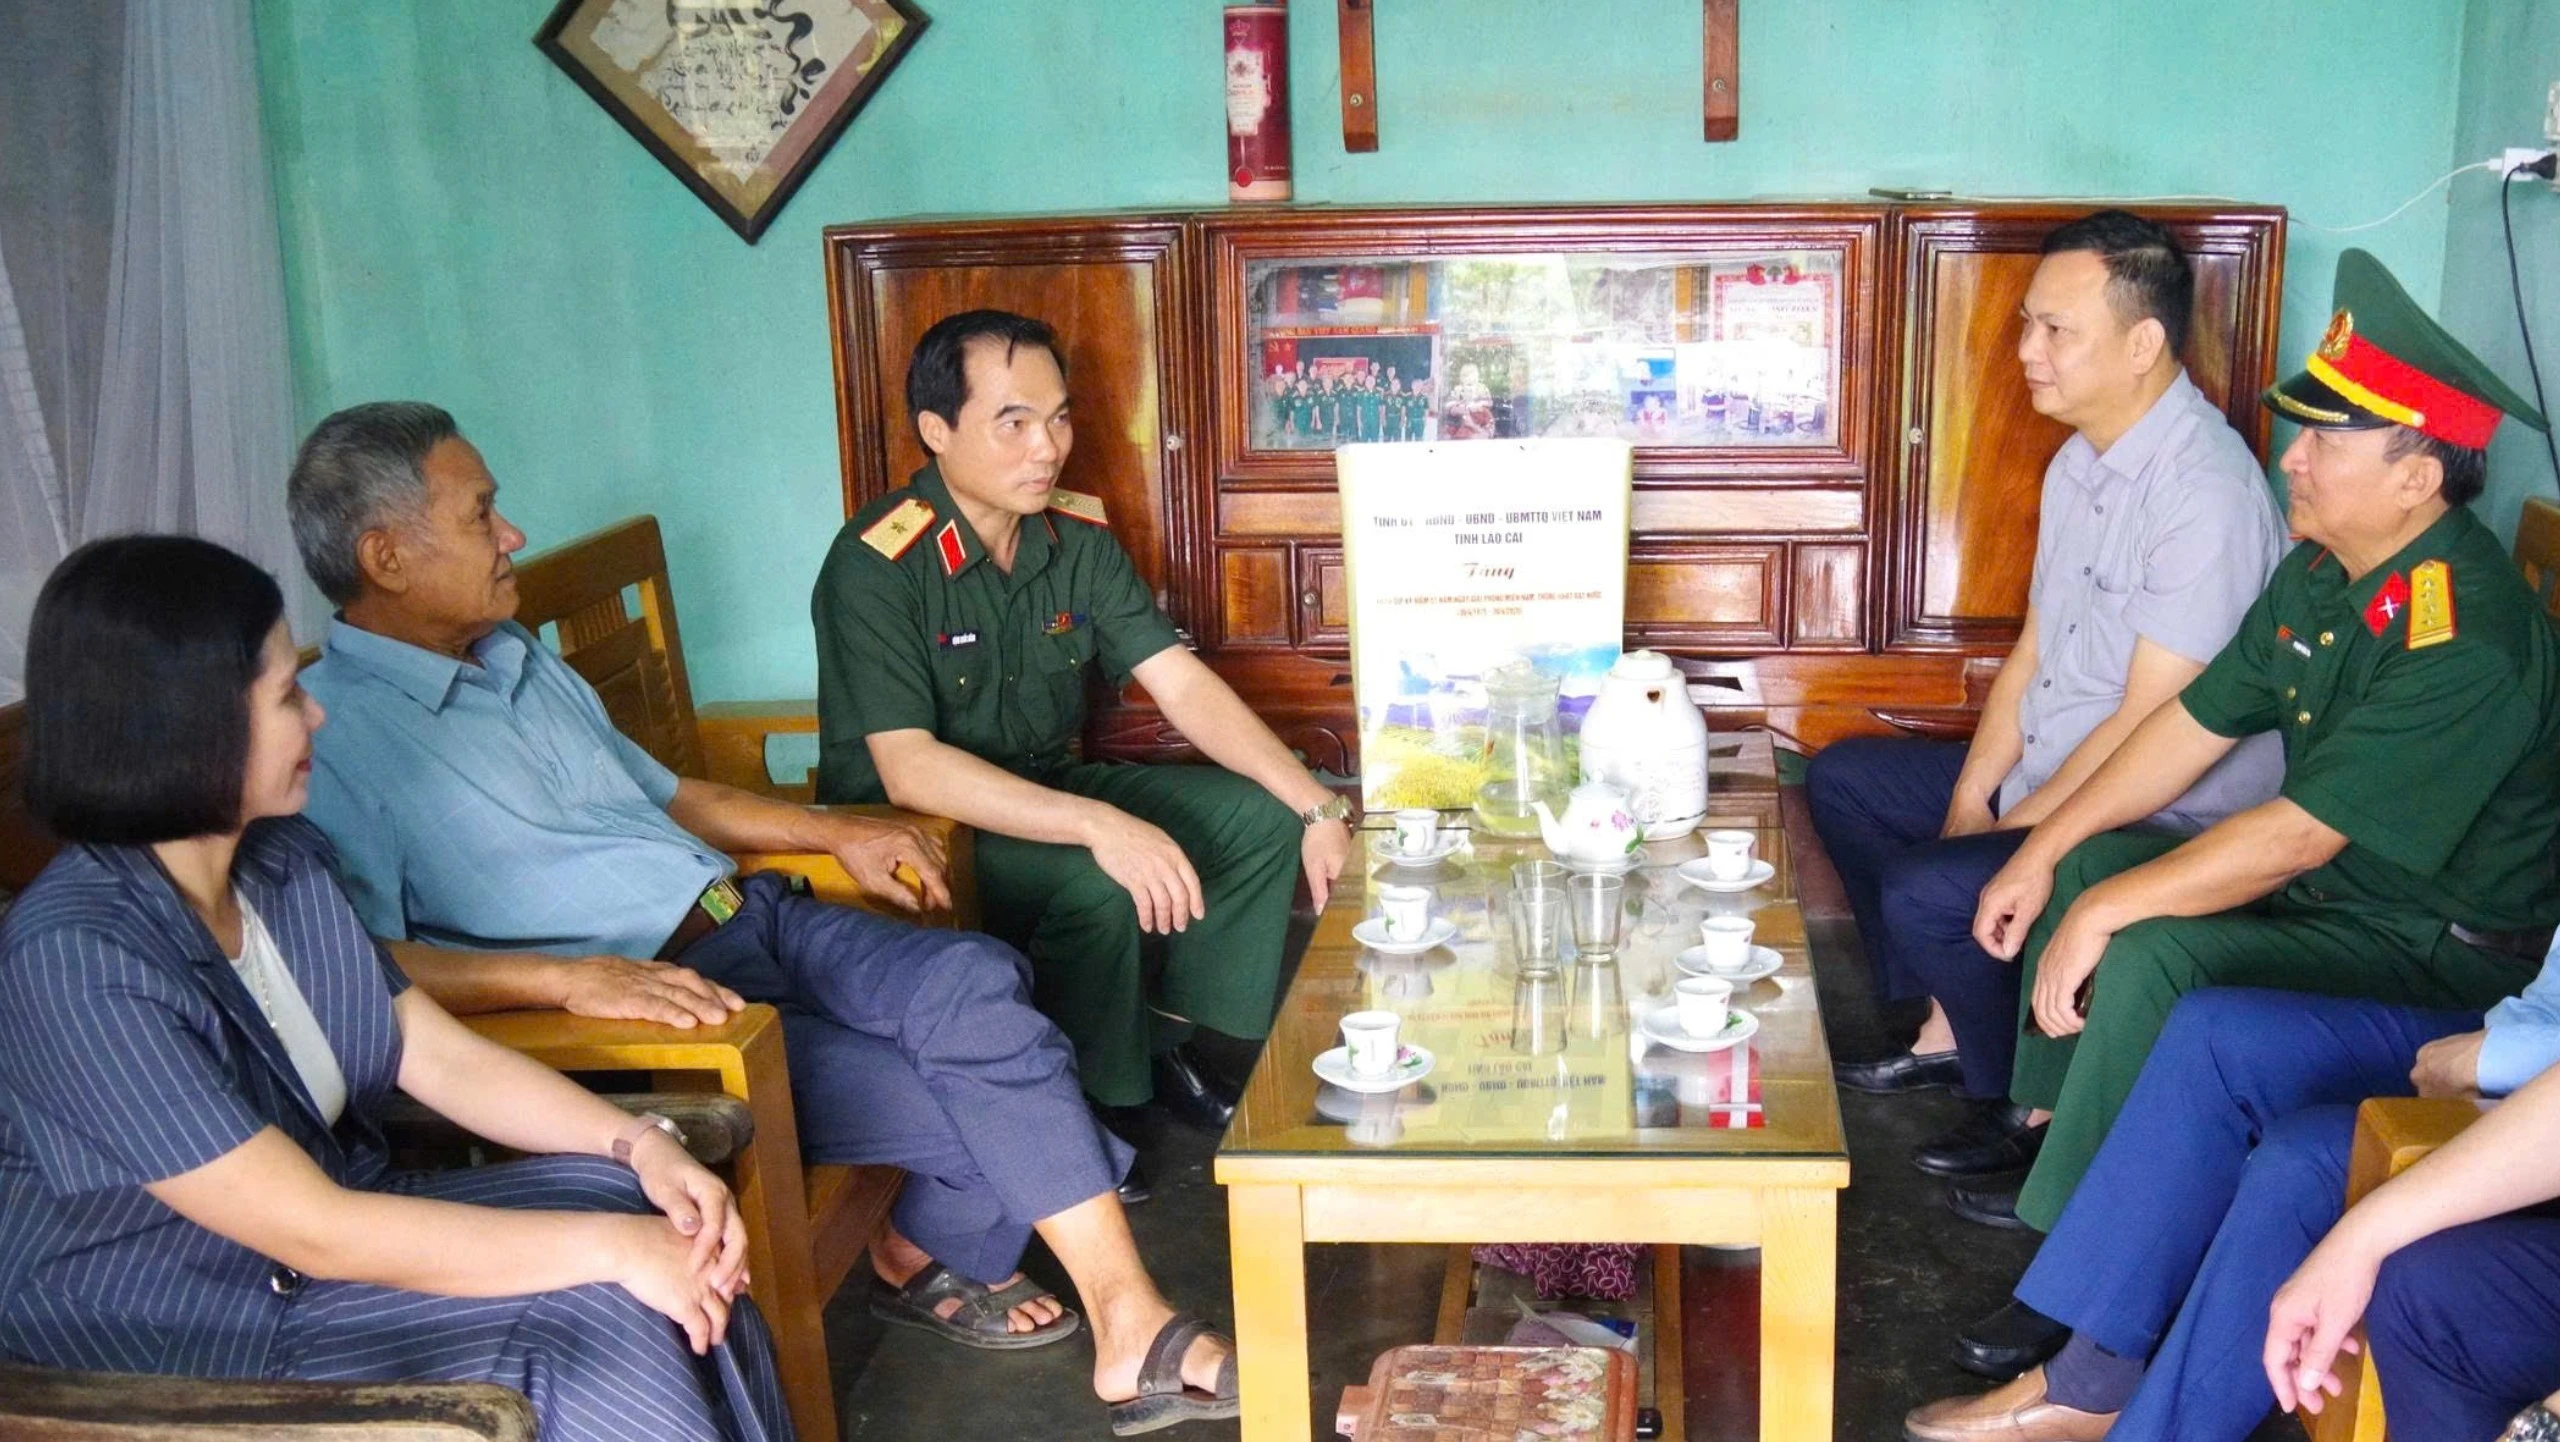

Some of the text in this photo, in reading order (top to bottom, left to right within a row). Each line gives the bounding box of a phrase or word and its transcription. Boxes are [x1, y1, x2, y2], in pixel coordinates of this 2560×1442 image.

[1465, 512, 1495, 525] UBND
[1577, 509, 1603, 522] NAM
[1504, 531, 1523, 544] CAI
